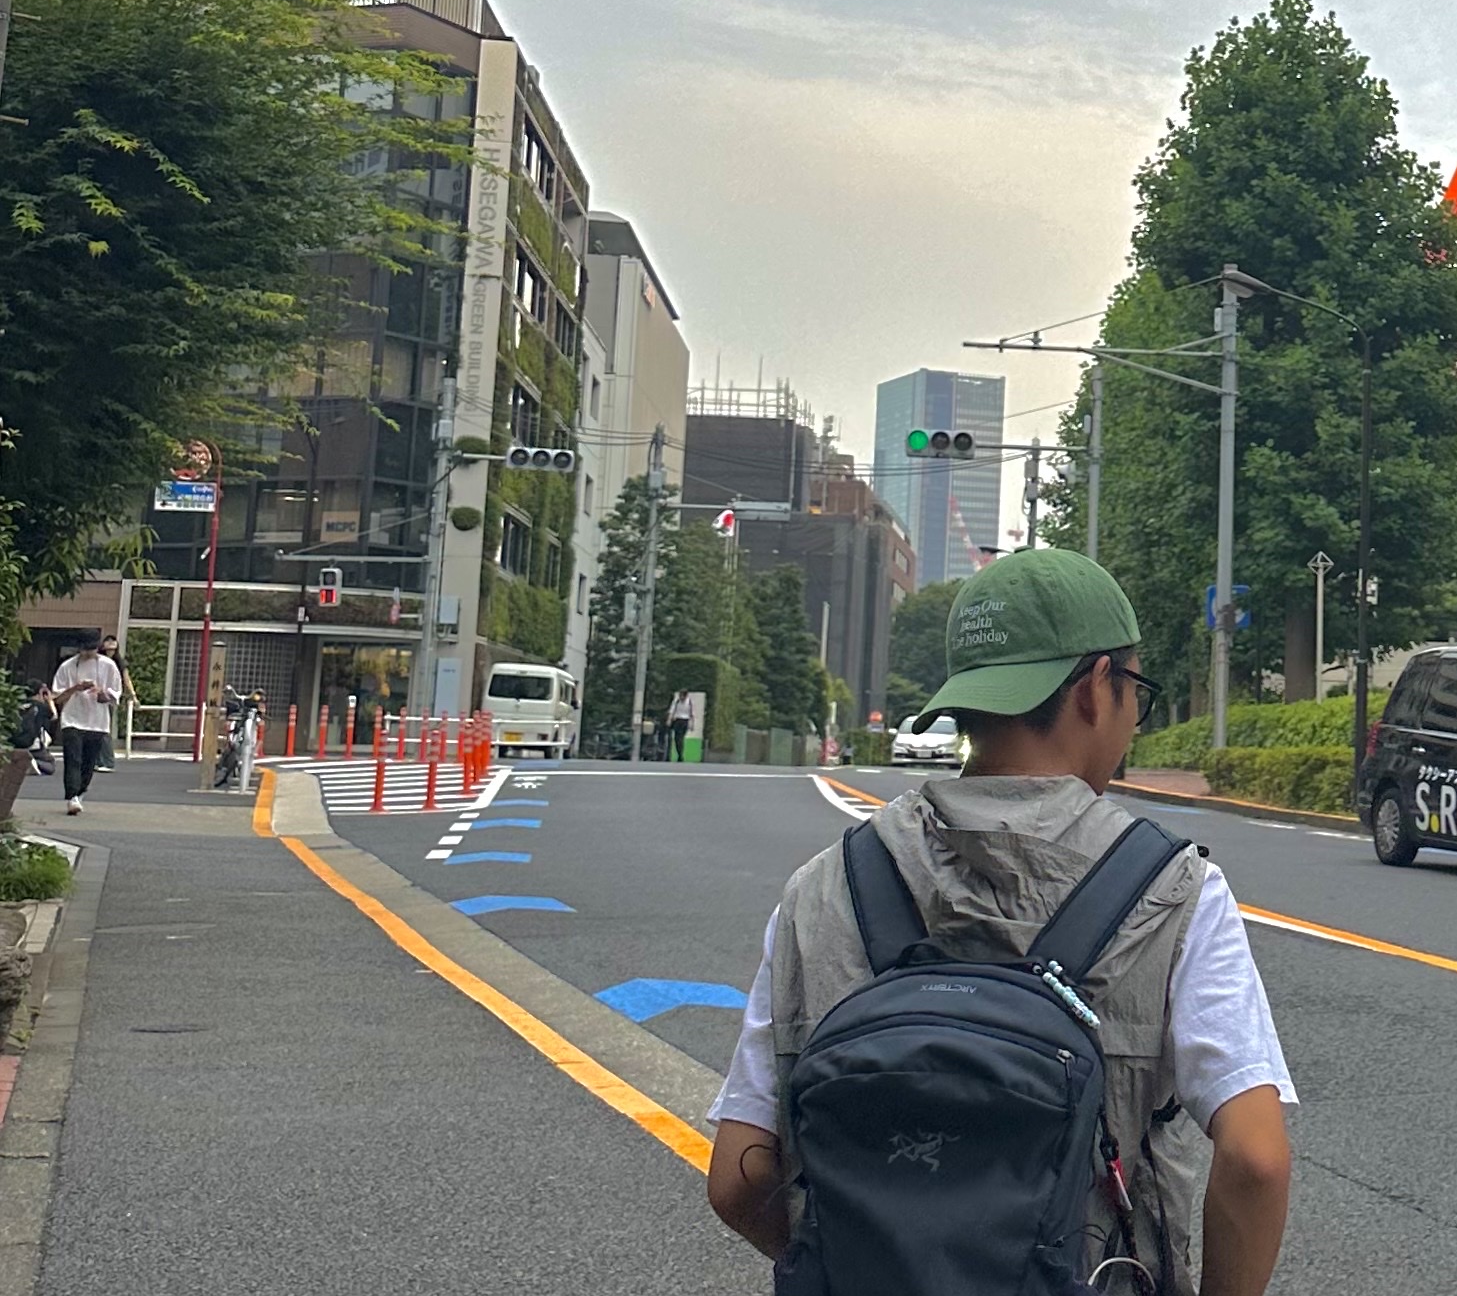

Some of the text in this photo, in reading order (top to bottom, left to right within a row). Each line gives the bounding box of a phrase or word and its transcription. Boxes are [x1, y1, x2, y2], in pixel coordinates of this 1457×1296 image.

[470, 282, 487, 335] GREEN
[465, 340, 482, 411] BUILDING
[982, 599, 1006, 612] Our
[965, 629, 1009, 647] holiday
